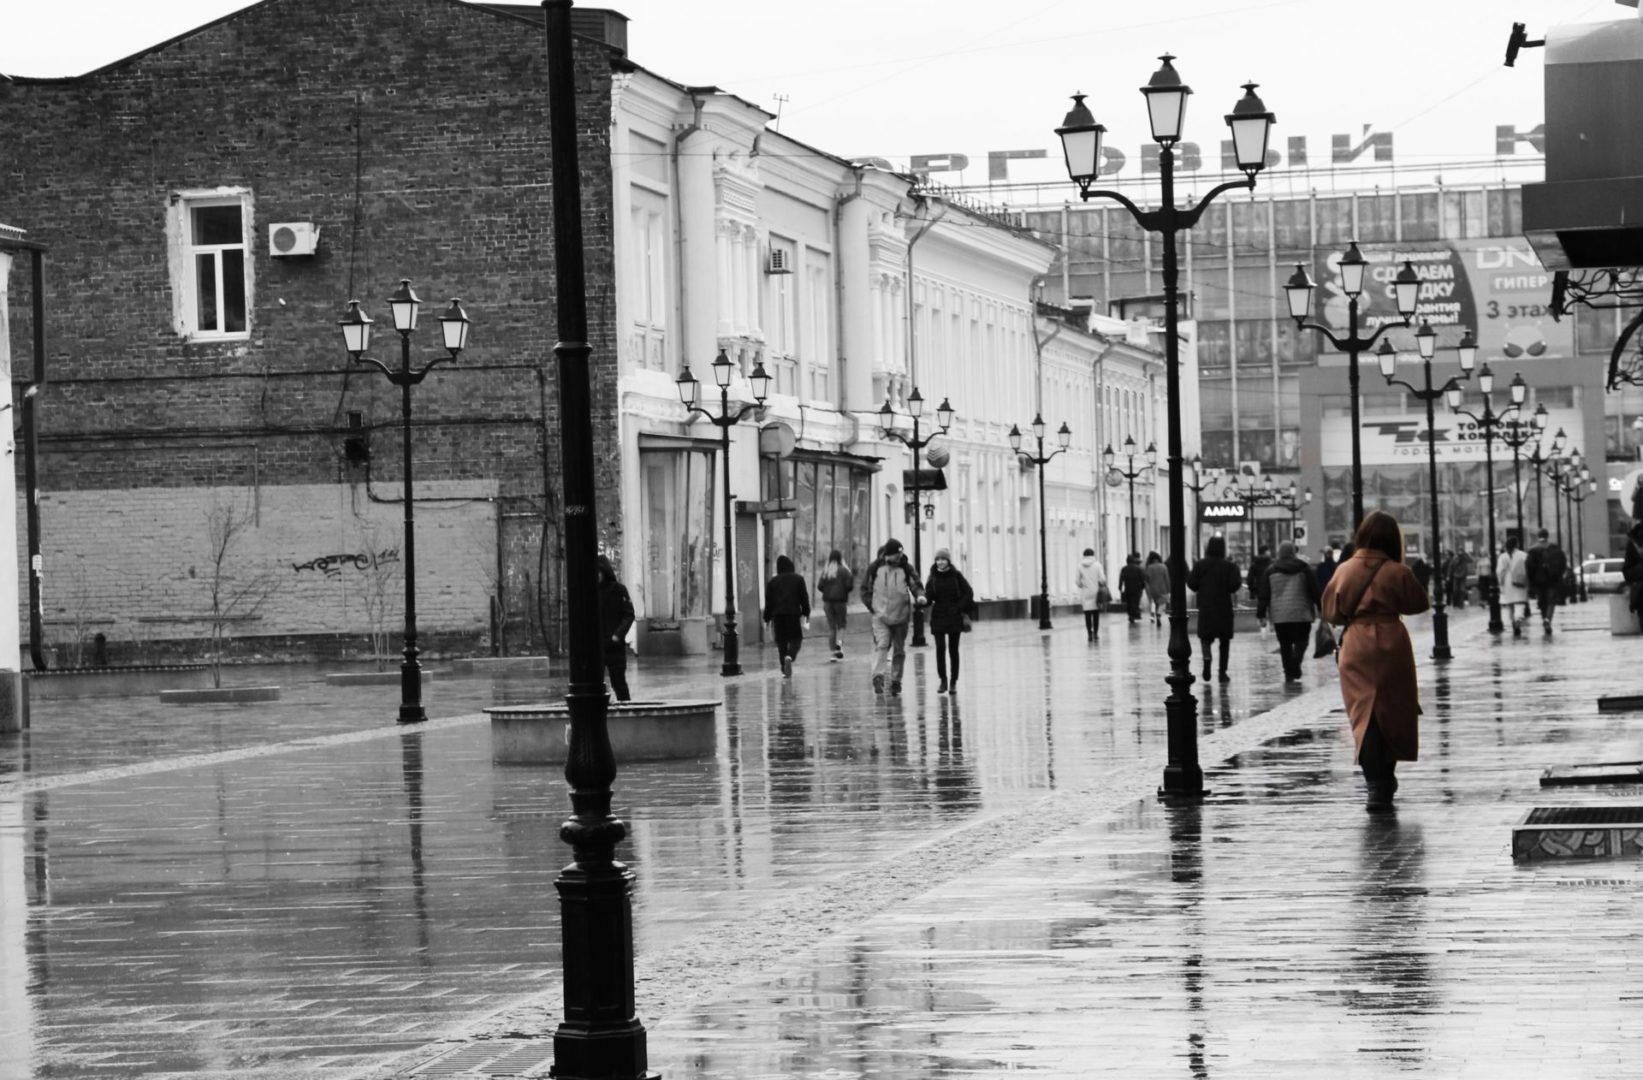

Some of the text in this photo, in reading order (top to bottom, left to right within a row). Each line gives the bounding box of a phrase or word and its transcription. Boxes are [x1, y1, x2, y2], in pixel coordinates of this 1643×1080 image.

[1477, 246, 1542, 269] DN
[1385, 281, 1455, 300] СДКУ
[1494, 275, 1548, 289] ГИПЕР
[1486, 300, 1500, 319] 3
